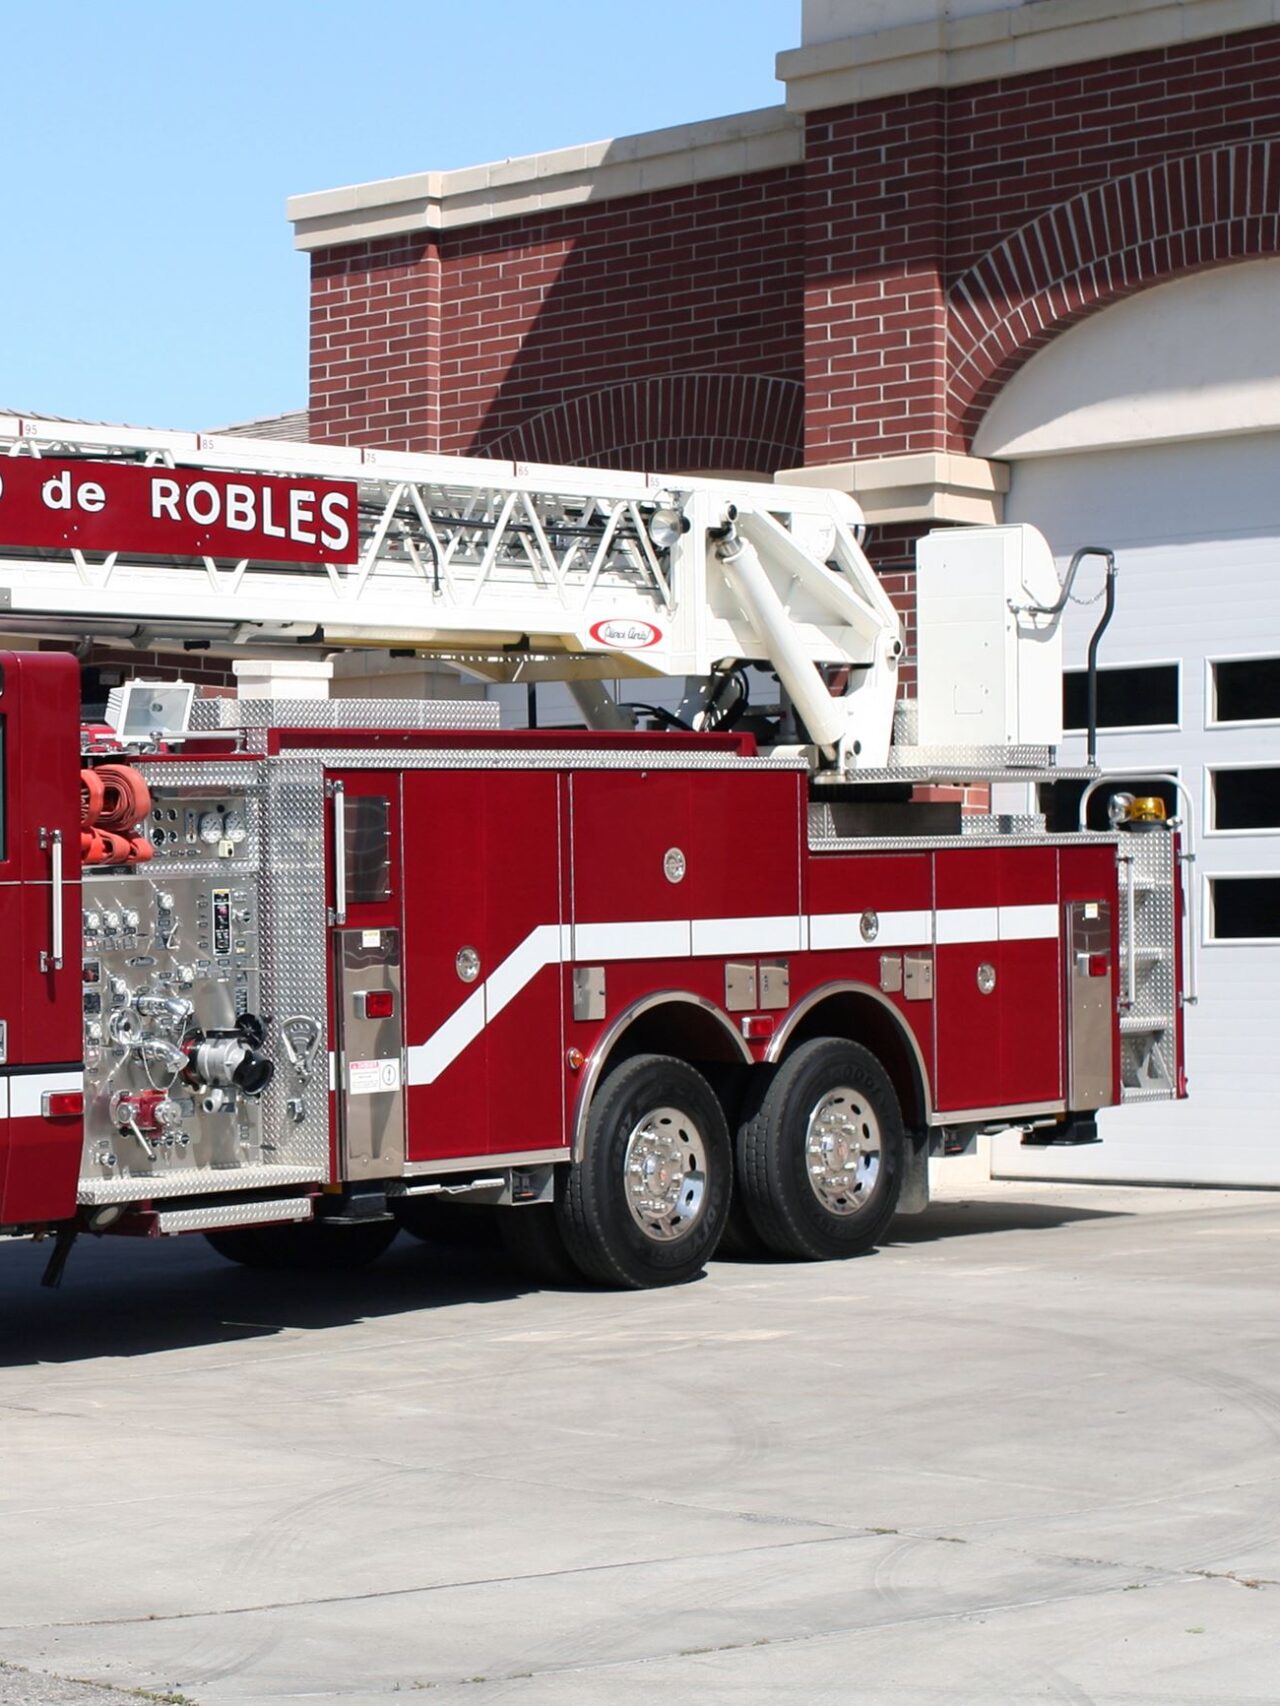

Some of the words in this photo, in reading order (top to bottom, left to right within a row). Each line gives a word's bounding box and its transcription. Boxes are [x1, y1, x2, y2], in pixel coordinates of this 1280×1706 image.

[25, 424, 38, 435] 95
[202, 439, 215, 450] 85
[41, 470, 106, 512] de
[151, 478, 350, 551] ROBLES
